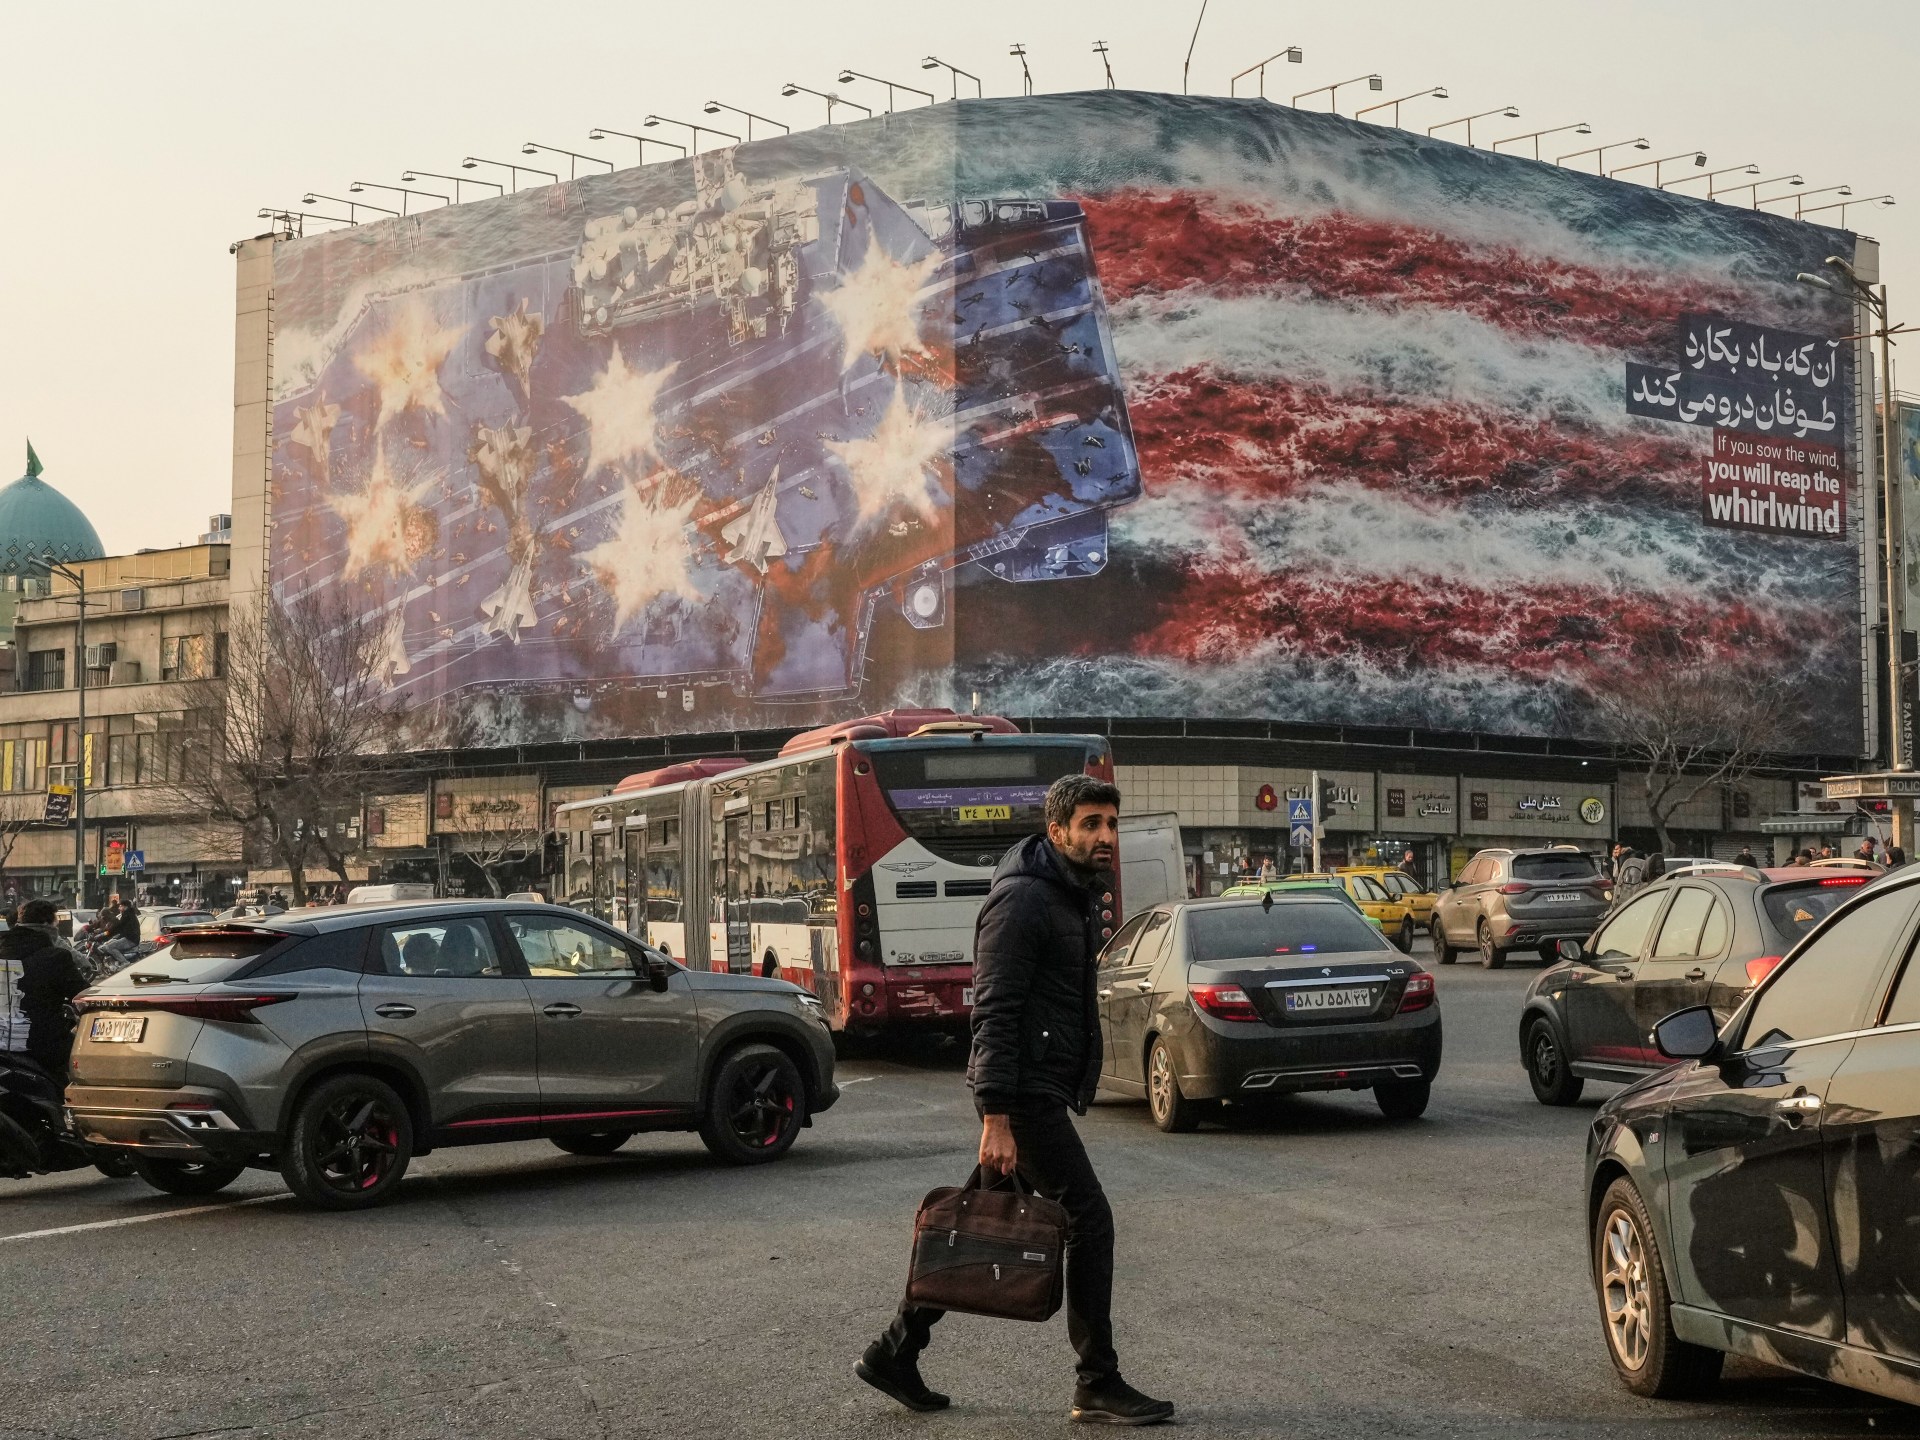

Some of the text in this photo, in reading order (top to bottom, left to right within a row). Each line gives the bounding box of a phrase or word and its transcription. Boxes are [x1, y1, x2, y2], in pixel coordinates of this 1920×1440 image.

[1685, 324, 1740, 374] بکارد
[1746, 334, 1781, 382] باد
[1755, 388, 1836, 437] طوفان
[1718, 435, 1840, 470] If you sow the wind,
[1708, 461, 1840, 495] you will reap the
[1709, 487, 1840, 534] whirlwind
[1519, 794, 1561, 811] کفش ملی
[1828, 783, 1844, 795] POLICE
[1296, 993, 1312, 1008] ۵۸
[1315, 992, 1324, 1006] ل
[1327, 991, 1352, 1006] ۵۵۸
